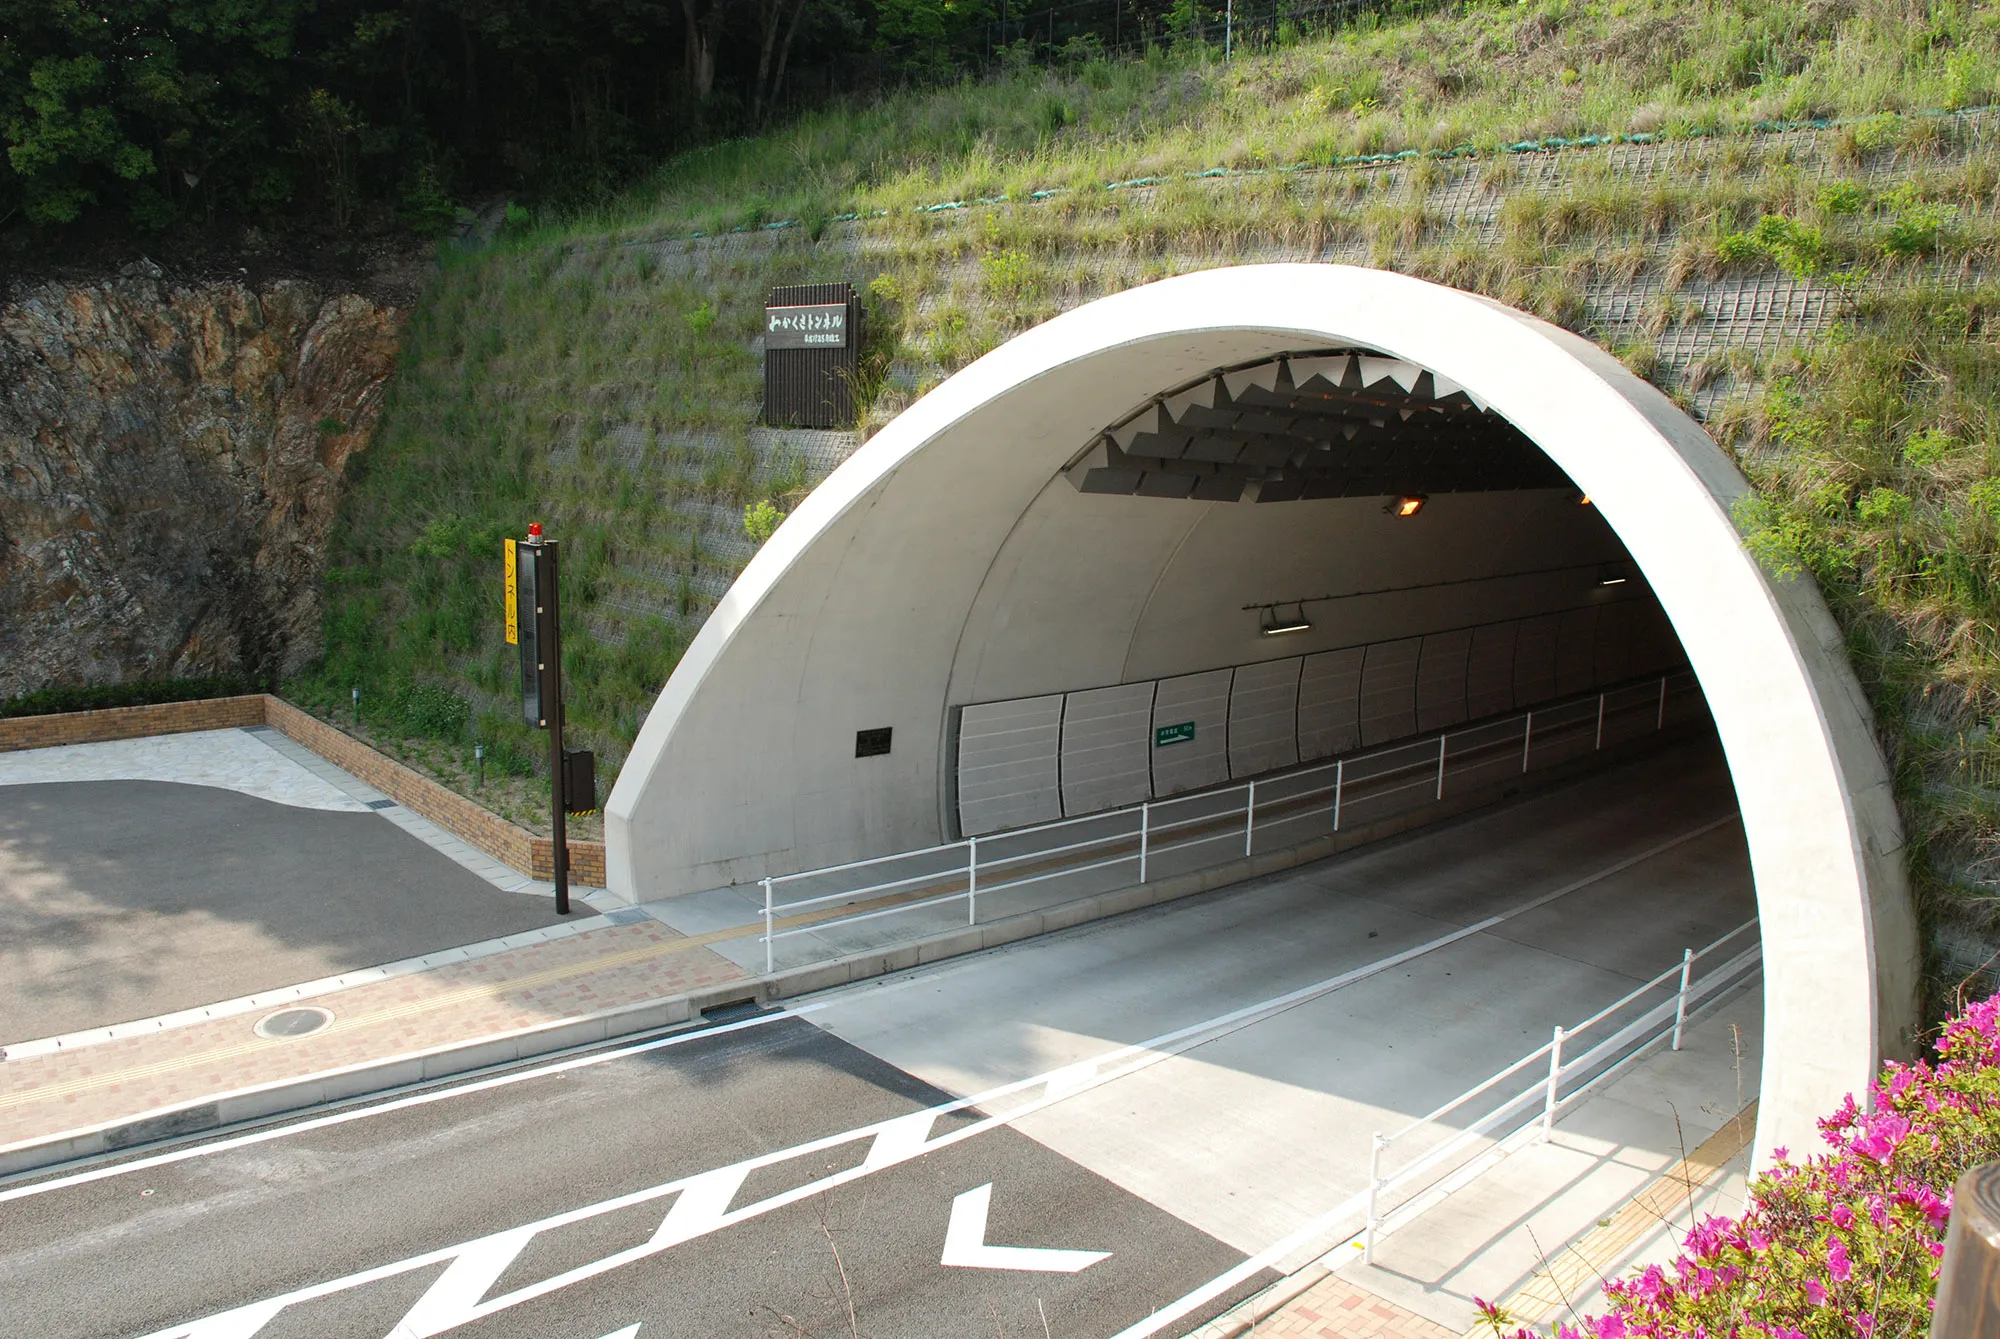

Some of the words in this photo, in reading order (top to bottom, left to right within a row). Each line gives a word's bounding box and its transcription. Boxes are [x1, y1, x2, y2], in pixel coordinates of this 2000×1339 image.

[507, 543, 516, 640] トンネル内
